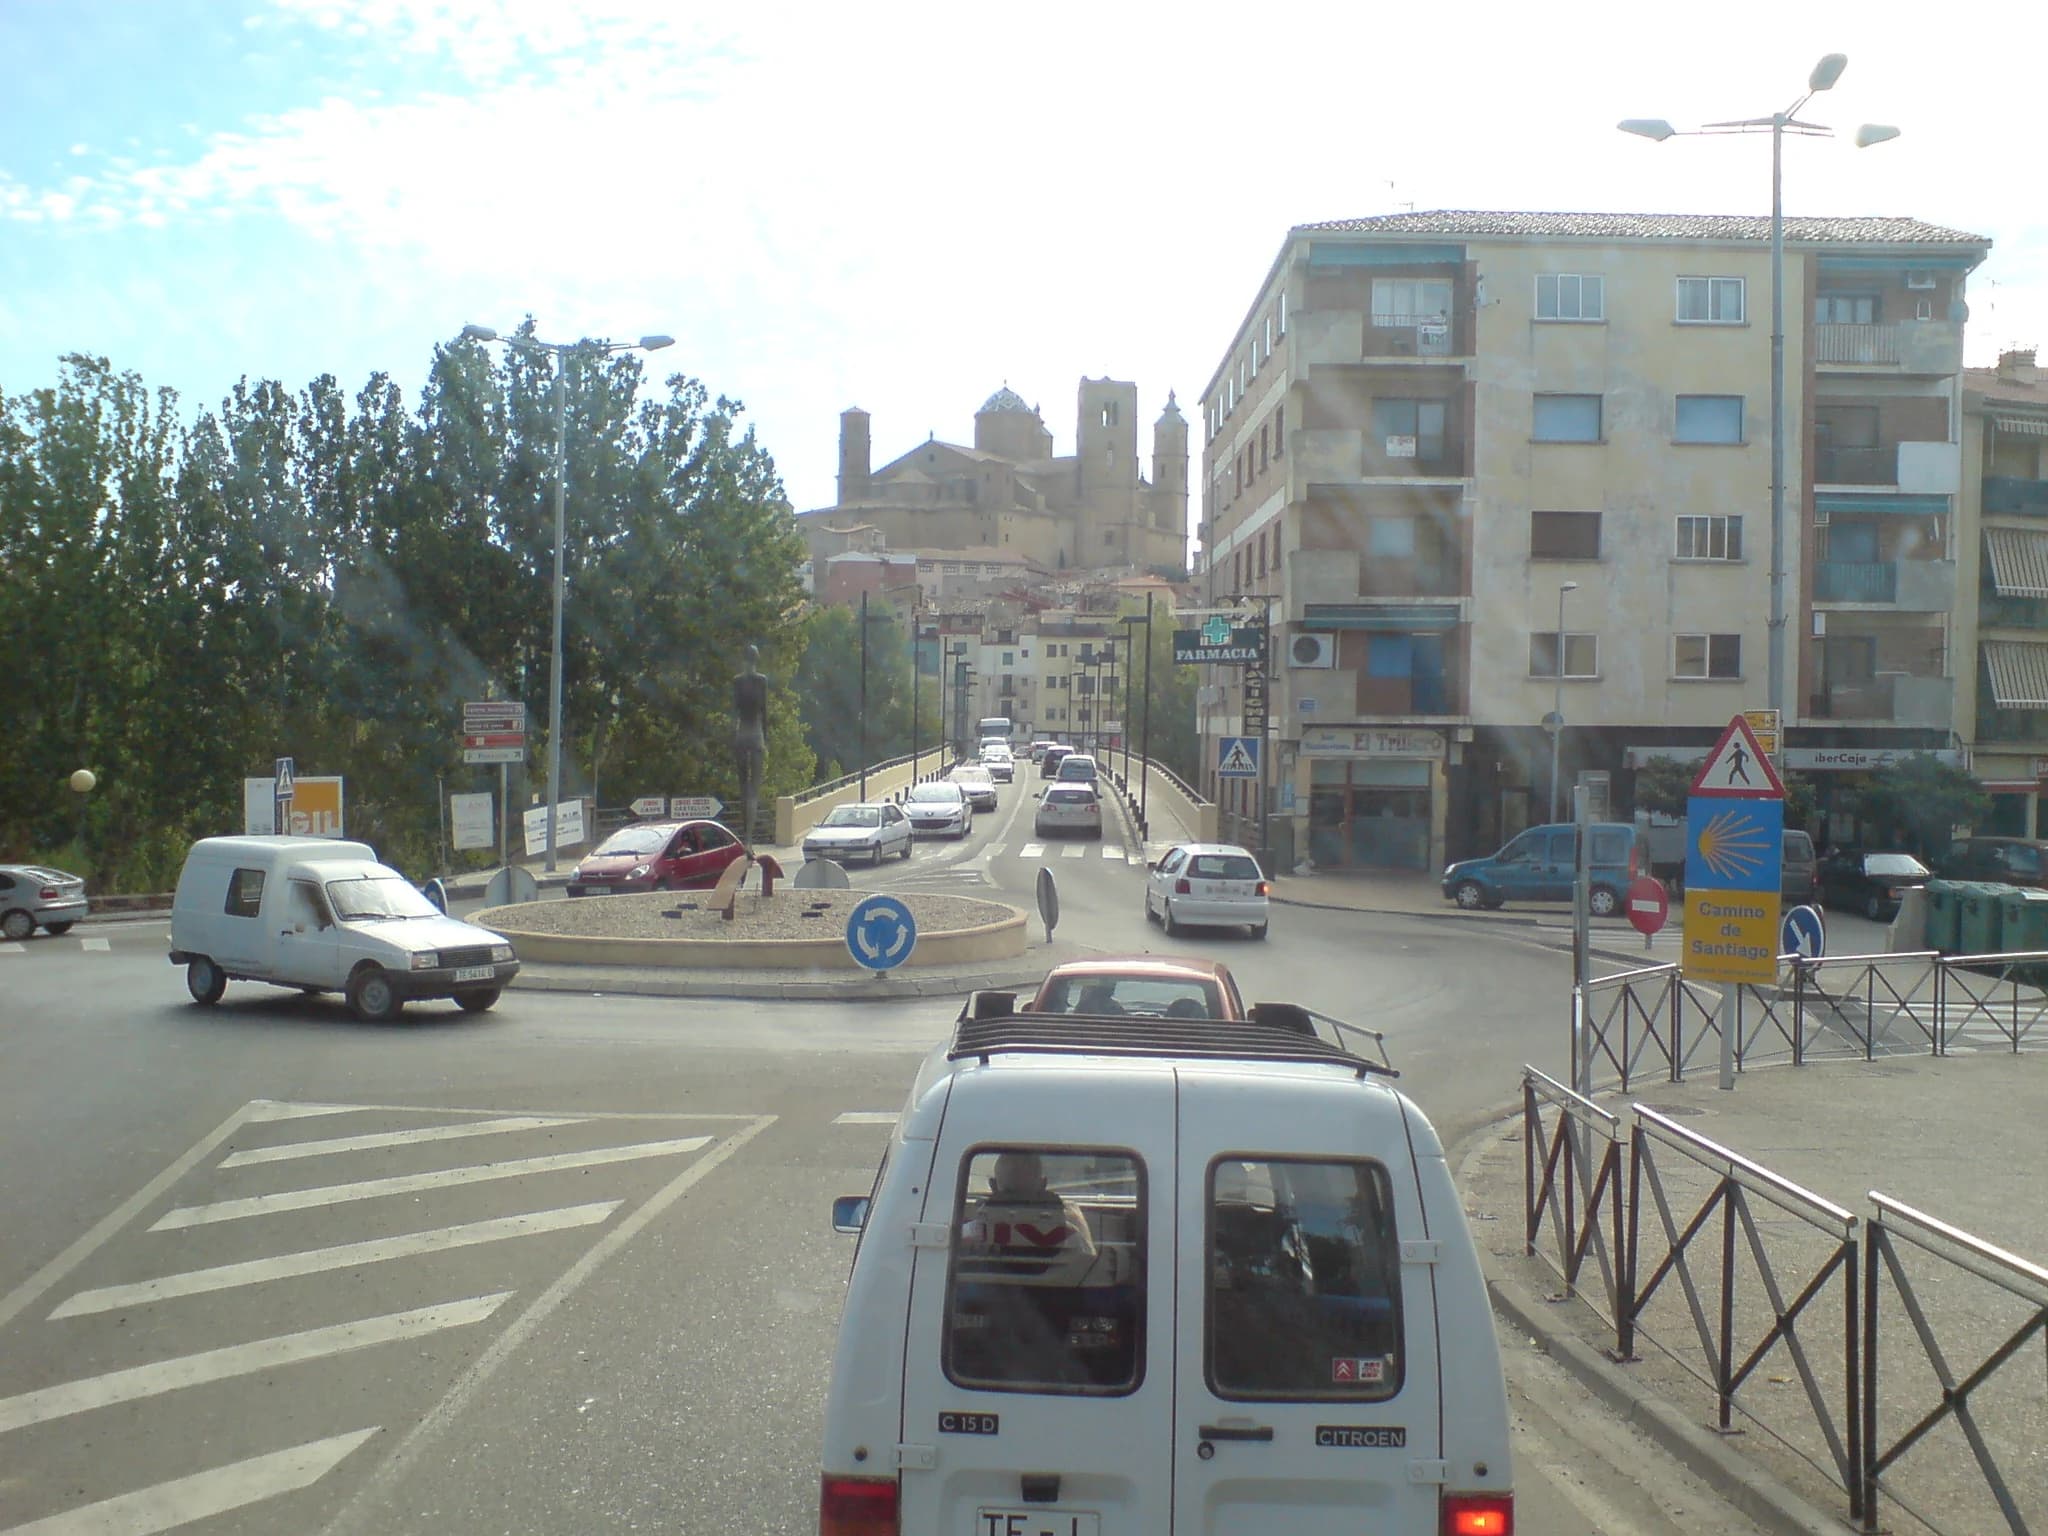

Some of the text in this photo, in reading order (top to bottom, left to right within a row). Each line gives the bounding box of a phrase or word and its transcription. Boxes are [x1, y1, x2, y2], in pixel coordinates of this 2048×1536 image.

[1175, 648, 1258, 661] FARMACIA
[1700, 902, 1766, 919] Camino
[1721, 924, 1741, 937] de
[1692, 940, 1769, 960] Santiago
[942, 1416, 995, 1432] C 15 D
